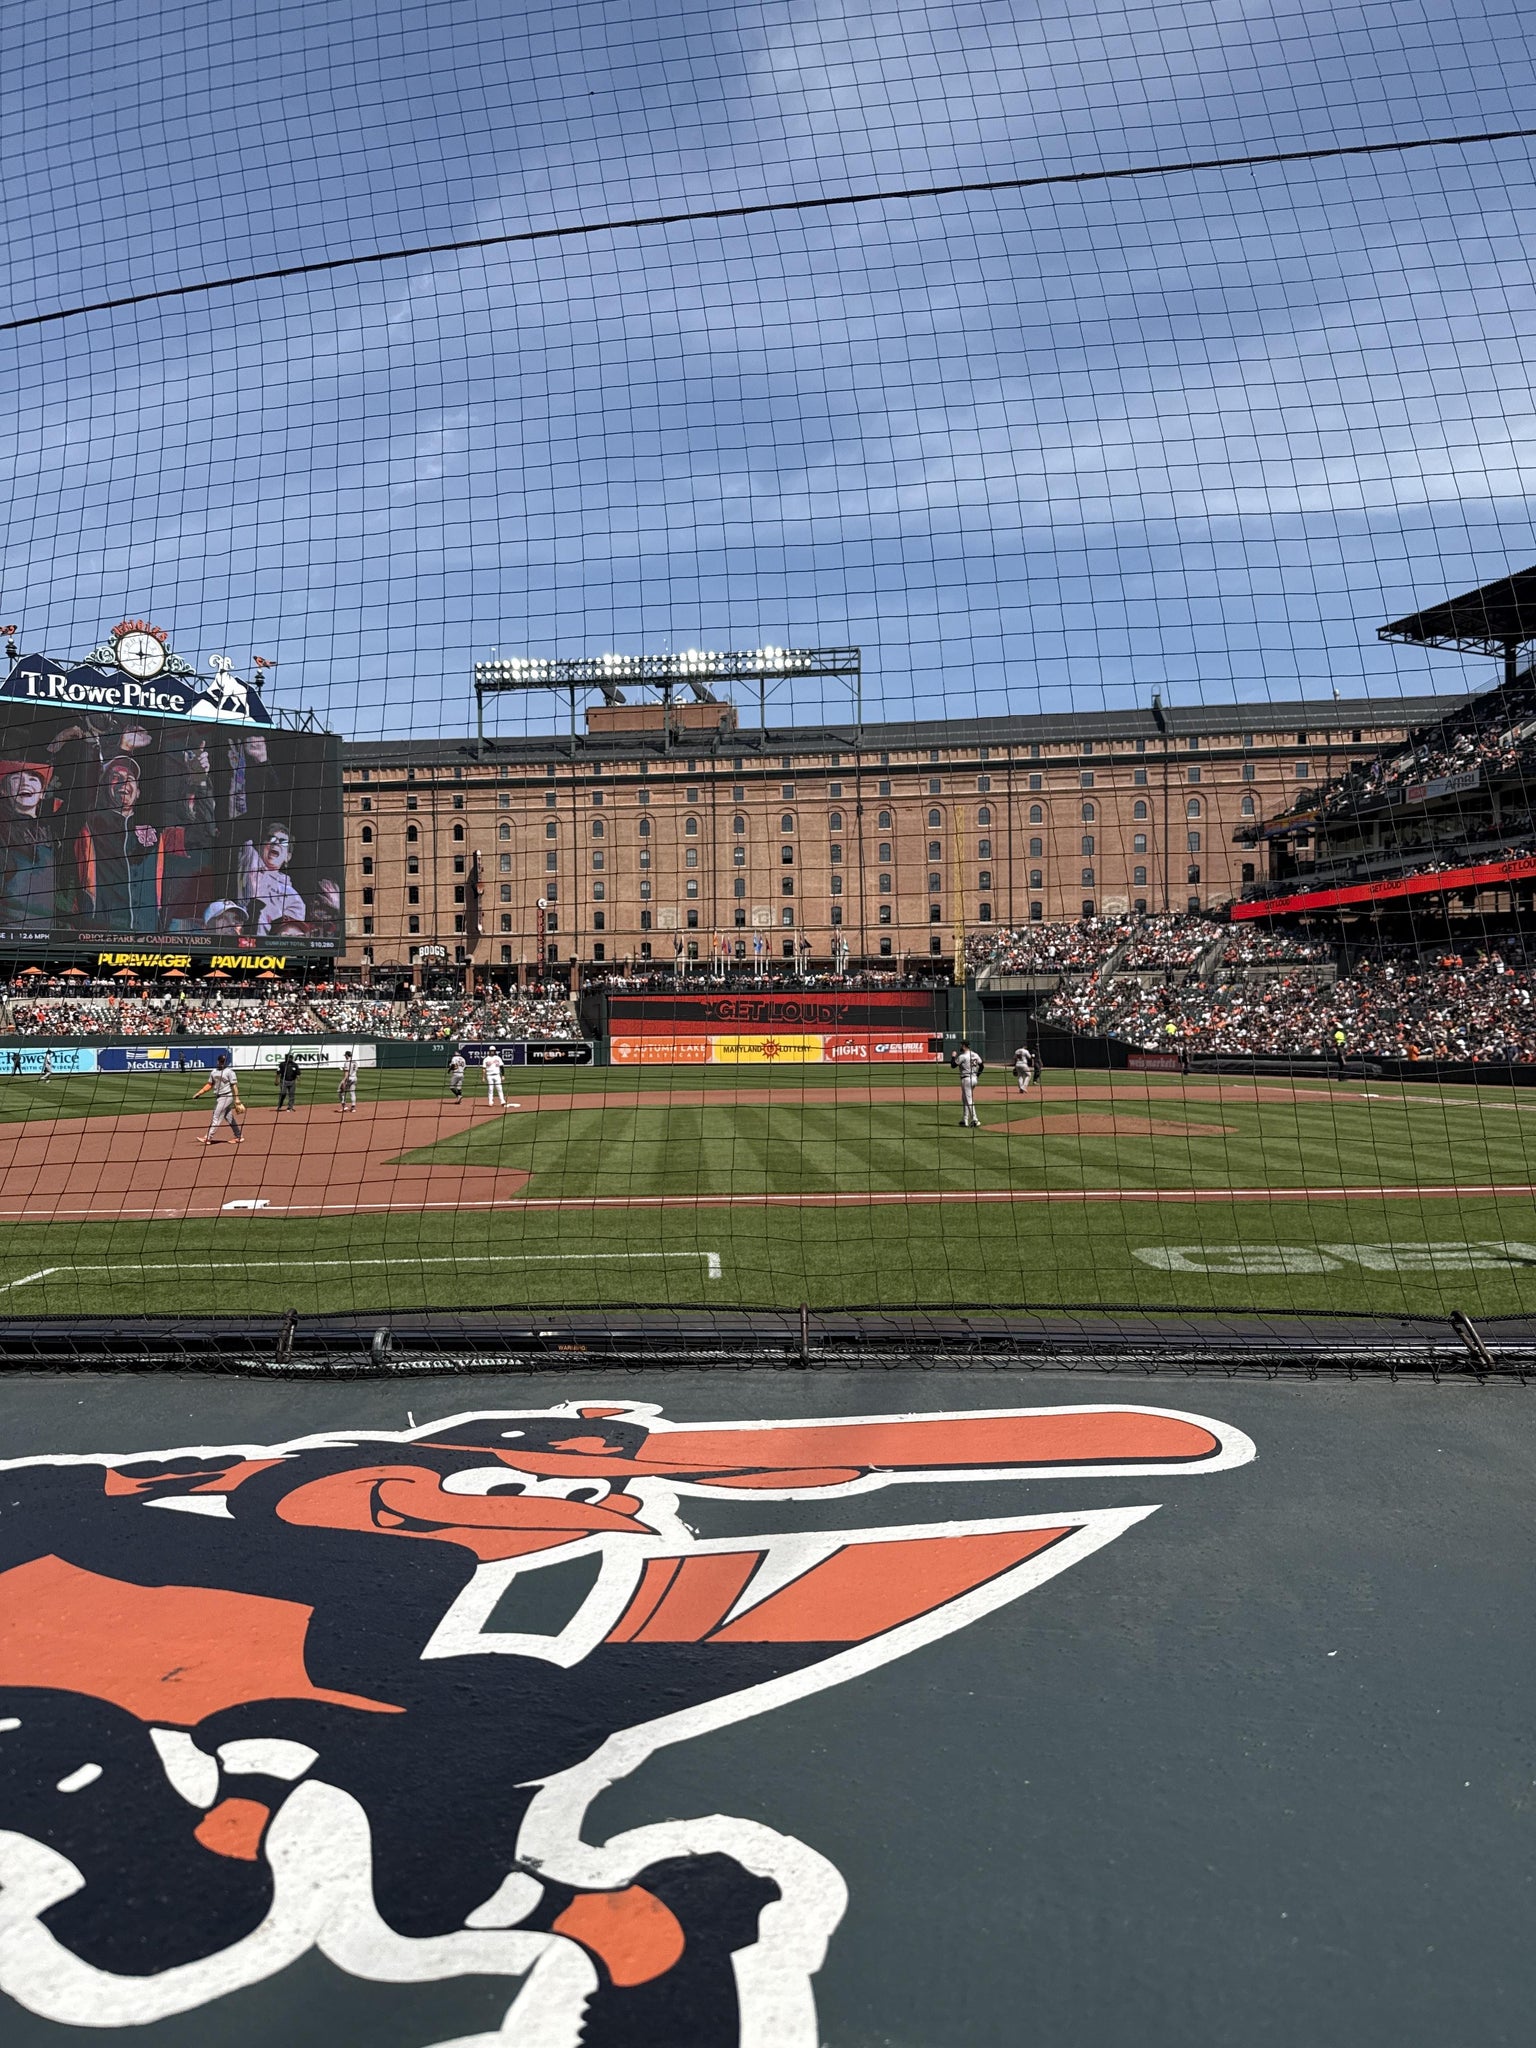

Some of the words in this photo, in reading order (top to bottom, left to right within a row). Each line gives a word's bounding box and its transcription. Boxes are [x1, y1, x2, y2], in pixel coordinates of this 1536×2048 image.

[49, 675, 121, 705] Rowe
[122, 682, 185, 712] Price
[1384, 881, 1401, 889] LOUD
[113, 935, 134, 943] PARK
[146, 935, 184, 944] CAMDEN
[185, 937, 211, 945] YARDS
[98, 953, 191, 967] PUREWAGER
[211, 955, 286, 969] PAVILION
[715, 1000, 765, 1020] GET
[767, 1001, 837, 1024] LOUD
[681, 1044, 706, 1052] LAKE
[723, 1045, 761, 1053] MARYLAND
[780, 1045, 811, 1053] LOTTERY
[127, 1060, 169, 1069] MedStar
